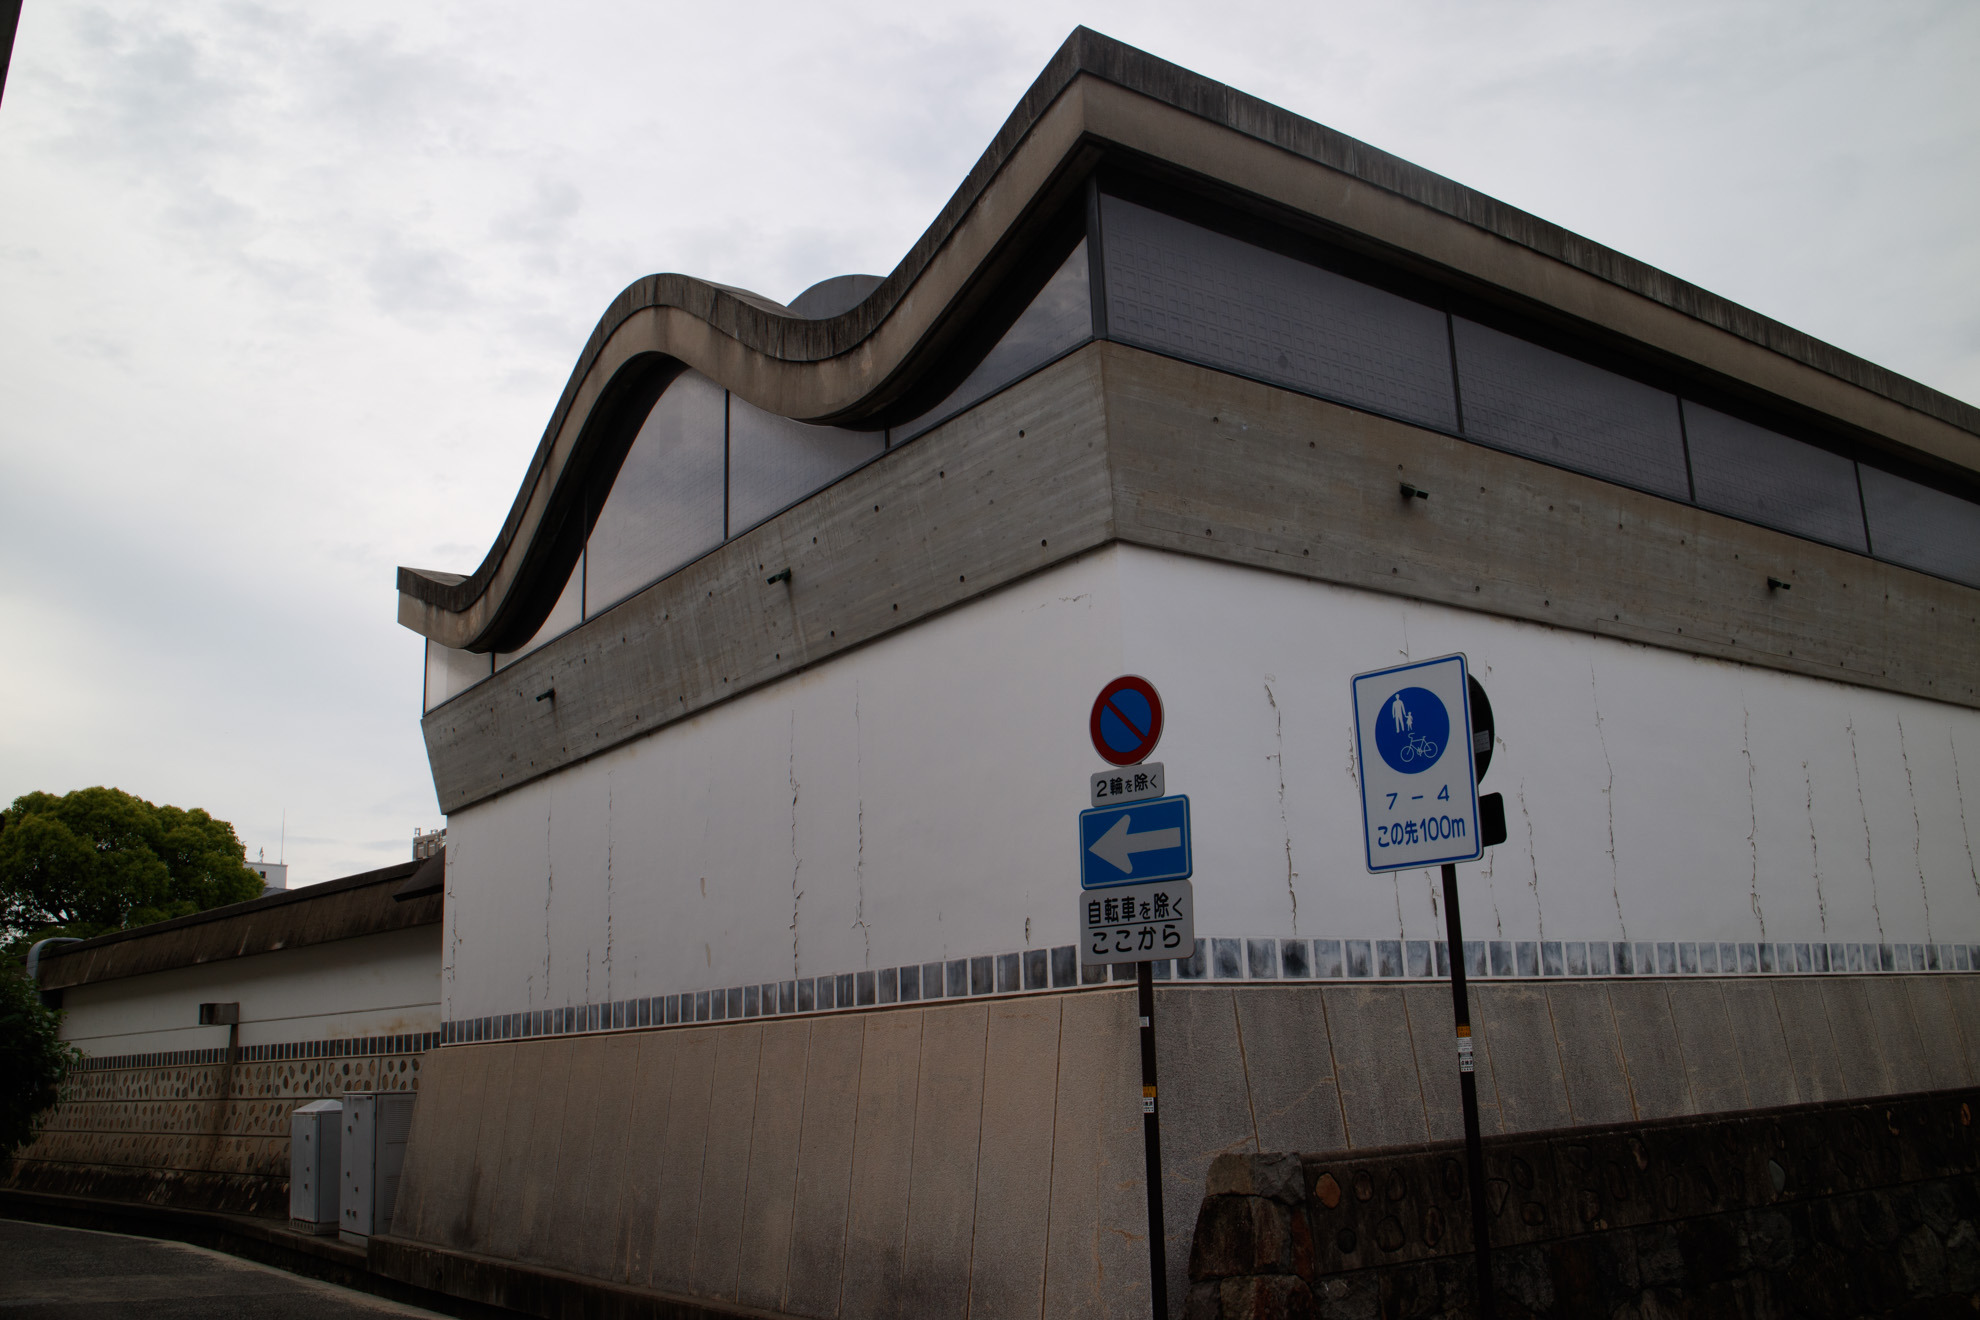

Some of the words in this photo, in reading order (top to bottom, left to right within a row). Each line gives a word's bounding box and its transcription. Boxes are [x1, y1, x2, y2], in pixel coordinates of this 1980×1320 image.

[1096, 772, 1158, 797] 2輪を除く
[1088, 892, 1183, 924] 自転車を除く
[1091, 924, 1181, 954] ここから
